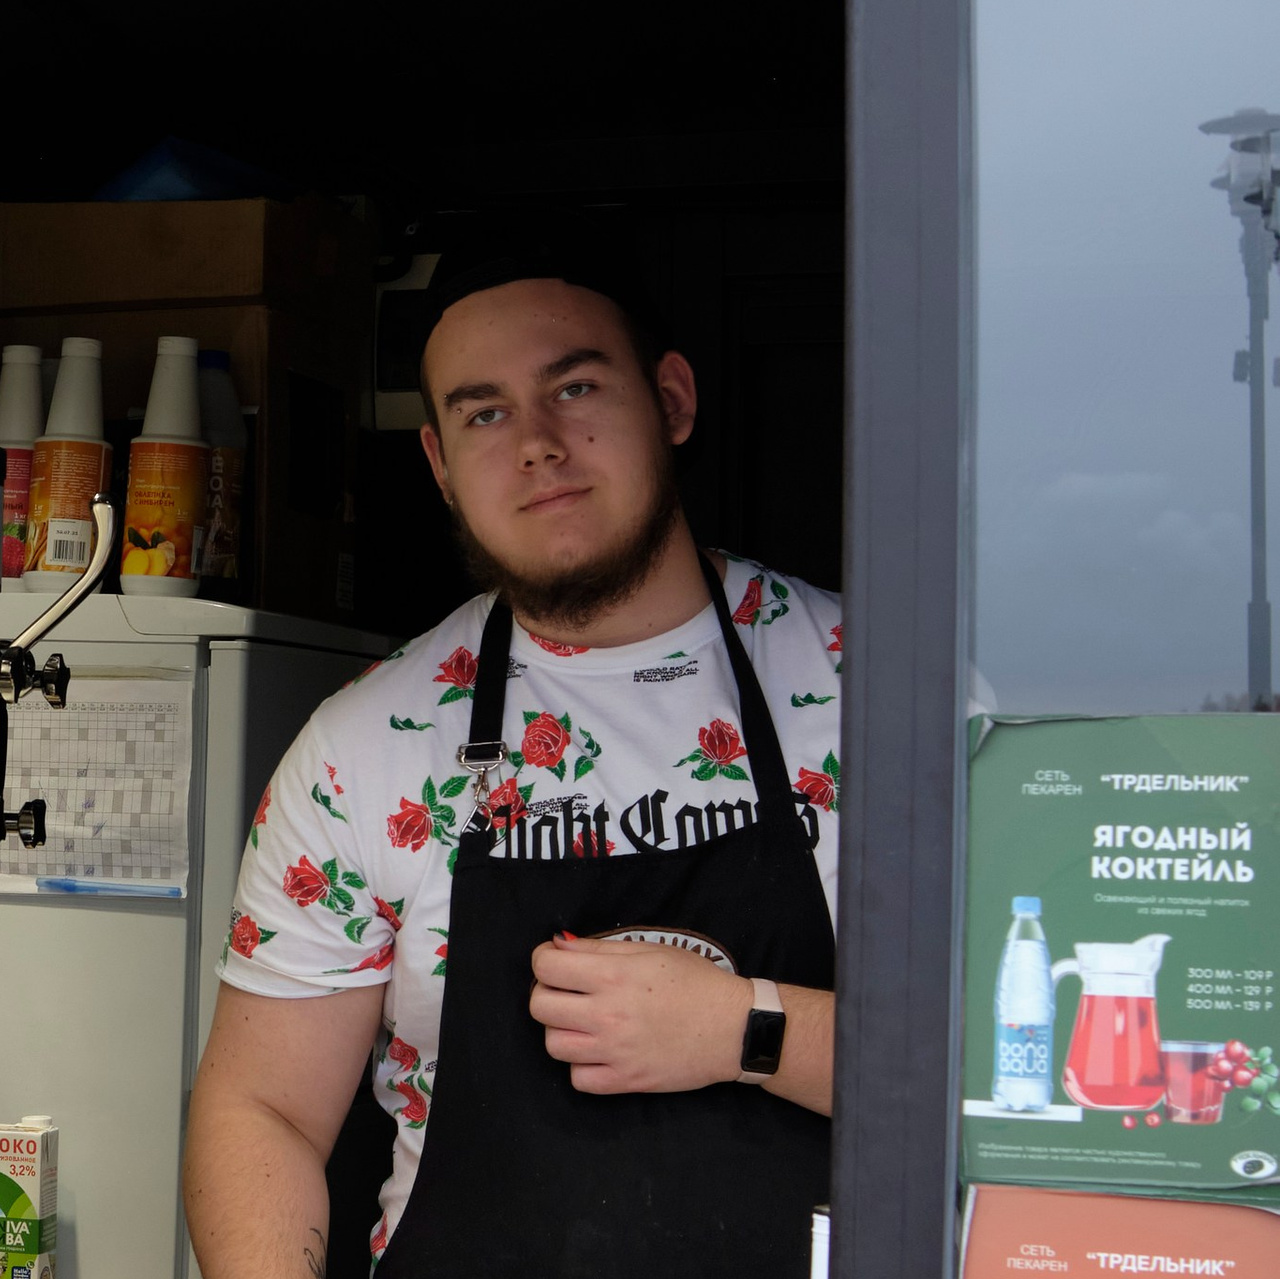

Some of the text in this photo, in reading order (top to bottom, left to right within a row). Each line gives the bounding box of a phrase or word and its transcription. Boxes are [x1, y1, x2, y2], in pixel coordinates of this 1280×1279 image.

[134, 491, 172, 499] ОБЛЕПИХА
[1034, 770, 1070, 782] СЕТЬ
[1022, 784, 1082, 796] ПЕКАРЕН
[1094, 823, 1252, 852] ЯГОДНЫЙ
[1092, 855, 1254, 882] КОКТЕЙЛЬ
[9, 1164, 36, 1177] 3,2%
[1020, 1244, 1056, 1258] СЕТЬ
[1006, 1258, 1068, 1272] ПЕКАРЕН
